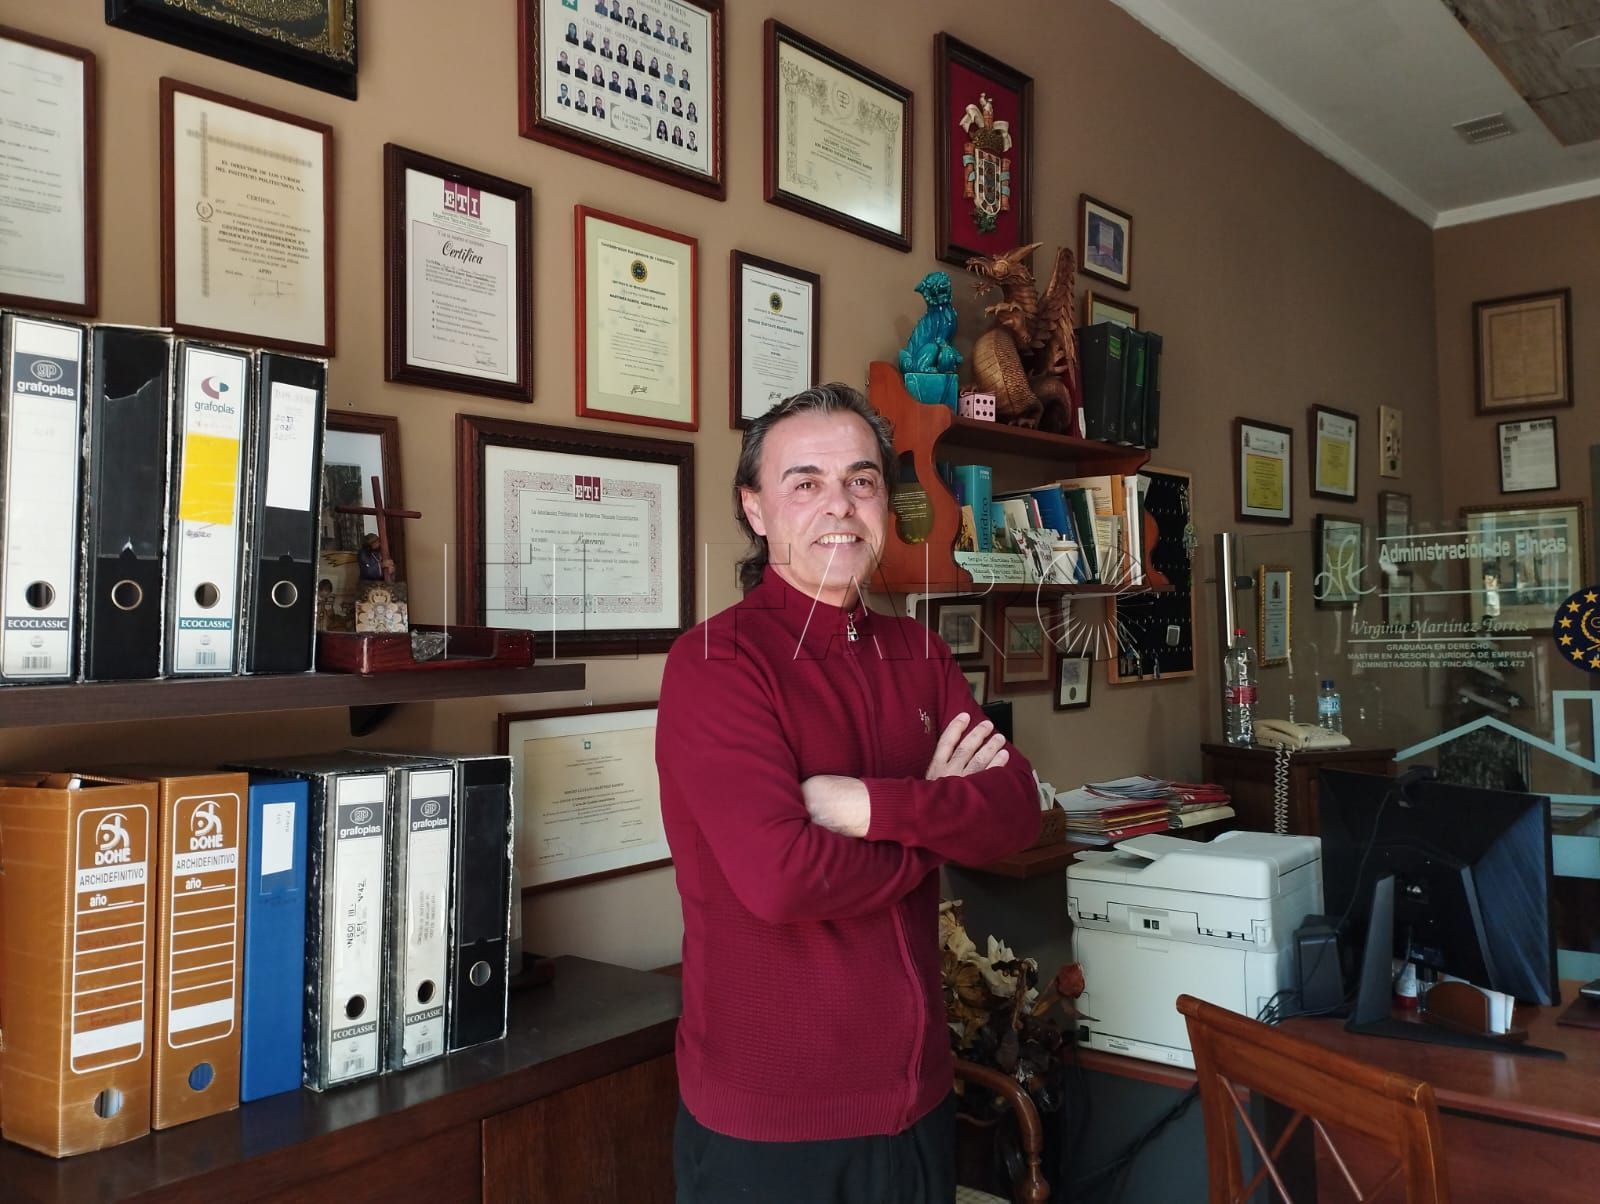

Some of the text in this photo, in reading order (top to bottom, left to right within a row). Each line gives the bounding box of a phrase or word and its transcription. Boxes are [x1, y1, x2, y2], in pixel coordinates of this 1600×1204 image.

[442, 240, 484, 265] Certifica
[16, 380, 75, 397] grafoplas
[194, 400, 236, 416] grafoplas
[575, 485, 599, 500] ETI
[1380, 534, 1567, 564] Administración de Fincas
[7, 619, 68, 630] ECOCLASSIC
[180, 619, 231, 630] ECOCLASSIC
[1447, 642, 1489, 650] DERECHO
[1491, 650, 1535, 659] EMPRESA
[1356, 661, 1428, 669] ADMINISTRADORA
[1429, 661, 1441, 669] DE
[412, 816, 448, 831] grafoplas
[340, 824, 382, 839] grafoplas
[189, 834, 224, 851] DOHE
[94, 847, 132, 866] DOHE
[176, 853, 236, 870] ARCHIDEFINITIVO
[79, 867, 145, 888] ARCHIDEFINITIVO
[185, 877, 202, 890] año
[89, 893, 108, 907] año
[406, 1008, 443, 1024] ECOCLASSIC
[332, 1023, 376, 1041] ECOCLASSIC
